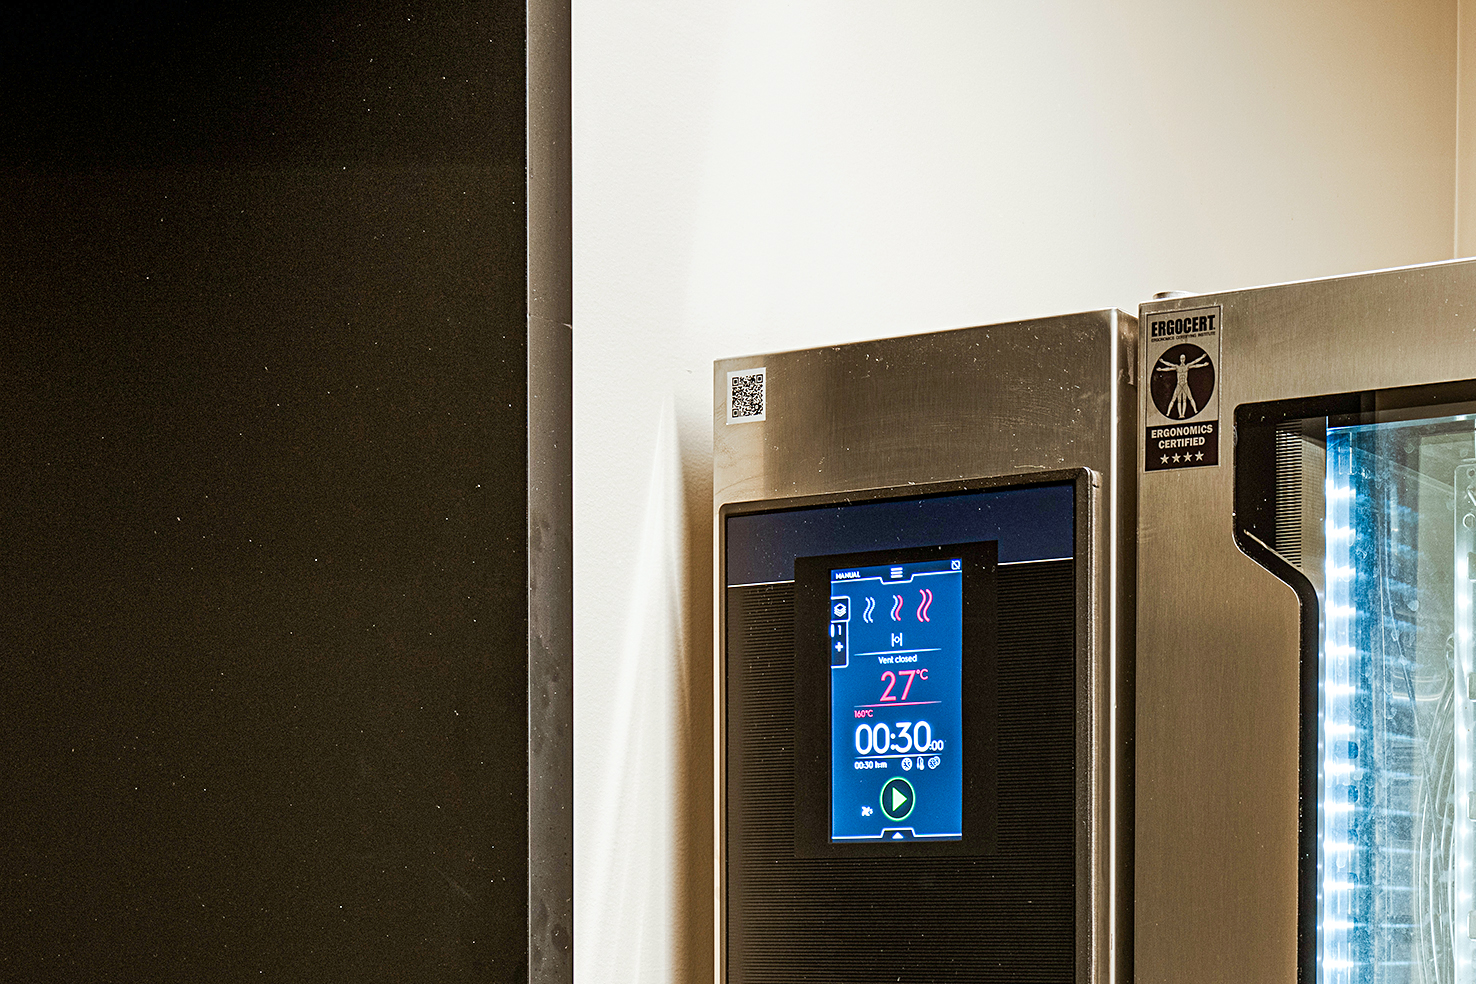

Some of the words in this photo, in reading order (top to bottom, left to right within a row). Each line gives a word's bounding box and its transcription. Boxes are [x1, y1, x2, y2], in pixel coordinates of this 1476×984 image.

[1151, 424, 1213, 439] ERGONOMICS
[1158, 436, 1206, 450] CERTIFIED
[835, 571, 861, 580] MANUAL
[878, 655, 894, 664] Vent
[894, 653, 918, 664] closed
[854, 760, 874, 770] 00:30
